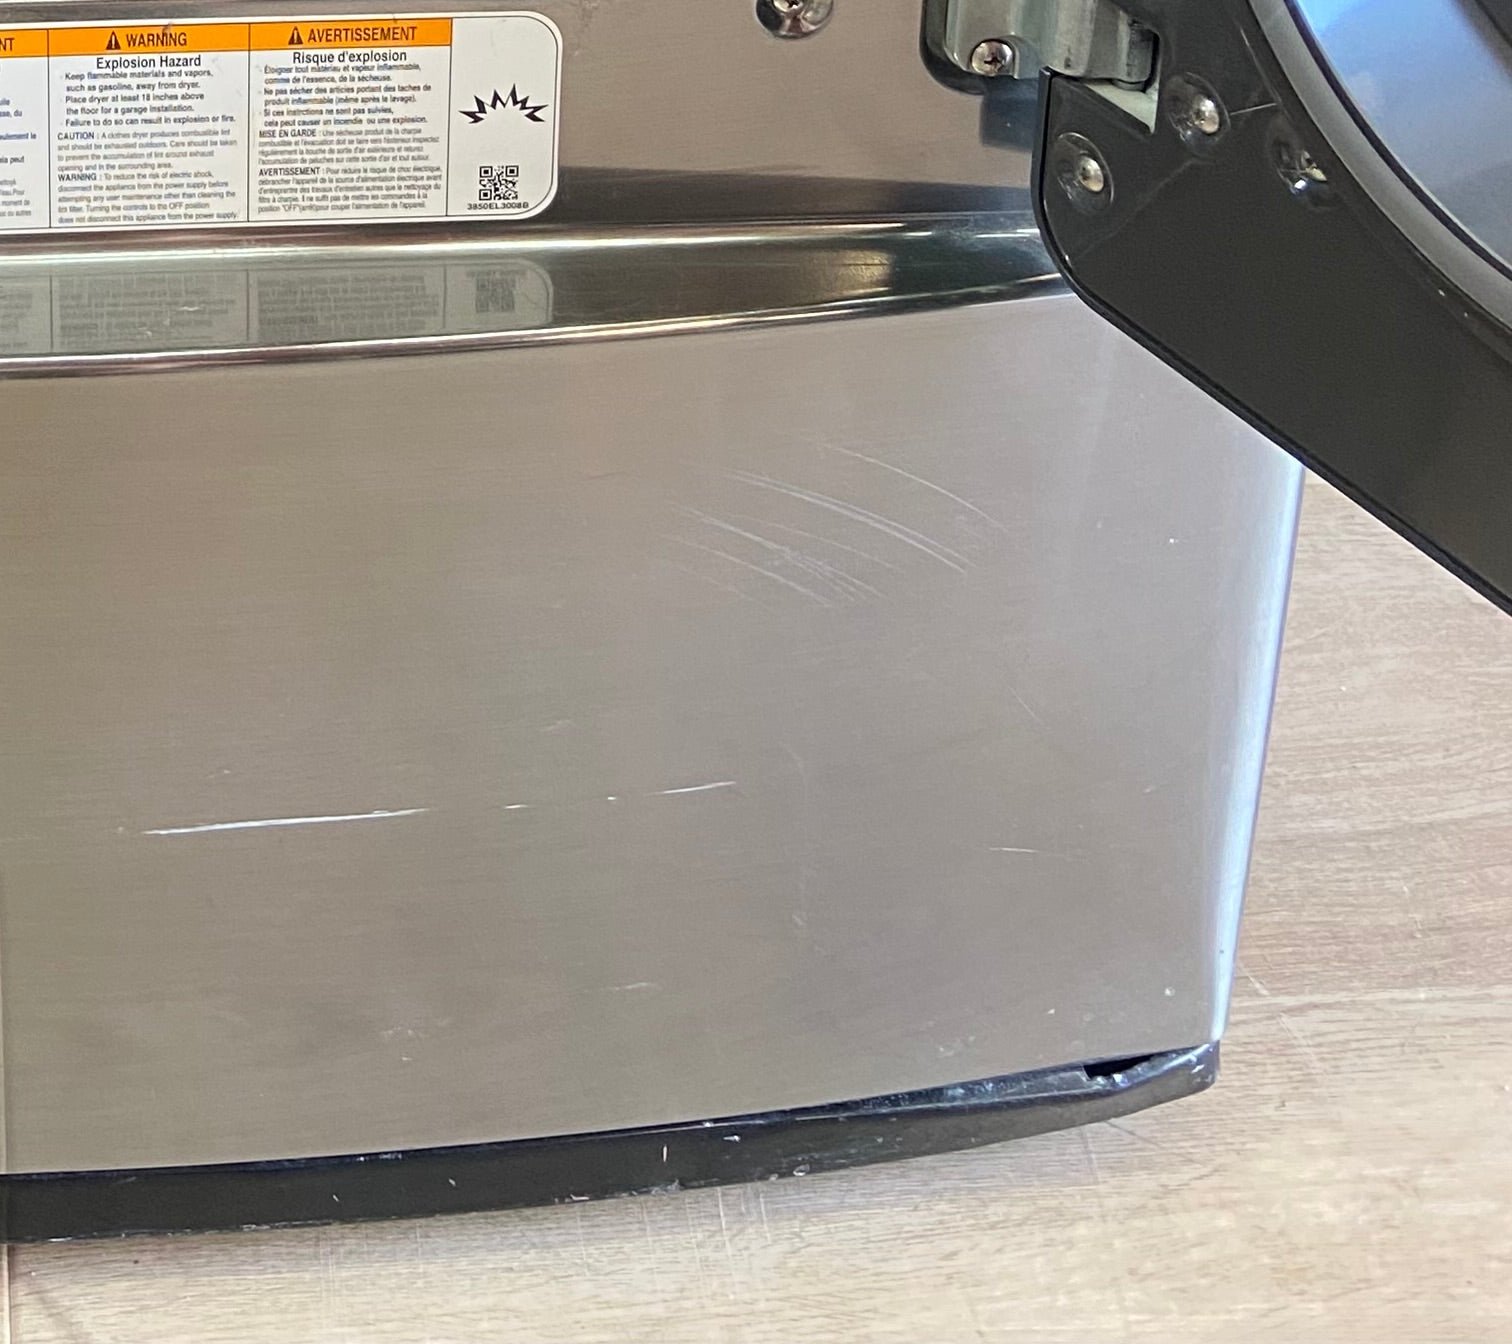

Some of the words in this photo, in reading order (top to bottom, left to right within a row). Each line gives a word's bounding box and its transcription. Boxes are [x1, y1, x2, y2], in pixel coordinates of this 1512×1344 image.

[126, 32, 187, 48] WARNING
[308, 26, 417, 43] AVERTISSEMENT
[96, 56, 155, 71] Explosion
[160, 55, 201, 68] Hazard
[293, 52, 334, 65] Risque
[338, 50, 407, 64] d'explosion
[65, 72, 85, 81] Keep
[88, 71, 127, 79] flammable
[130, 70, 165, 78] materials
[168, 69, 182, 77] and
[185, 69, 213, 78] vapors,
[66, 84, 85, 92] such
[98, 83, 134, 92] gasoline,
[136, 83, 156, 91] away
[158, 81, 176, 89] from
[178, 81, 200, 89] dryer.
[65, 96, 86, 104] Place
[88, 95, 109, 104] dryer
[121, 94, 139, 102] least
[153, 93, 178, 101] inches
[180, 92, 205, 100] above
[66, 107, 78, 115] the
[101, 106, 112, 114] for
[121, 106, 148, 115] garage
[150, 104, 194, 112] installation.
[65, 119, 91, 127] Failure
[103, 118, 112, 126] do
[141, 116, 162, 124] result
[173, 115, 210, 124] explosion
[222, 114, 235, 122] fire.
[57, 132, 94, 140] CAUTION
[259, 129, 276, 138] MISE
[279, 129, 288, 138] EN
[291, 129, 317, 137] GARDE
[58, 173, 97, 182] WARNING
[259, 167, 320, 177] AVERTISSEMENT
